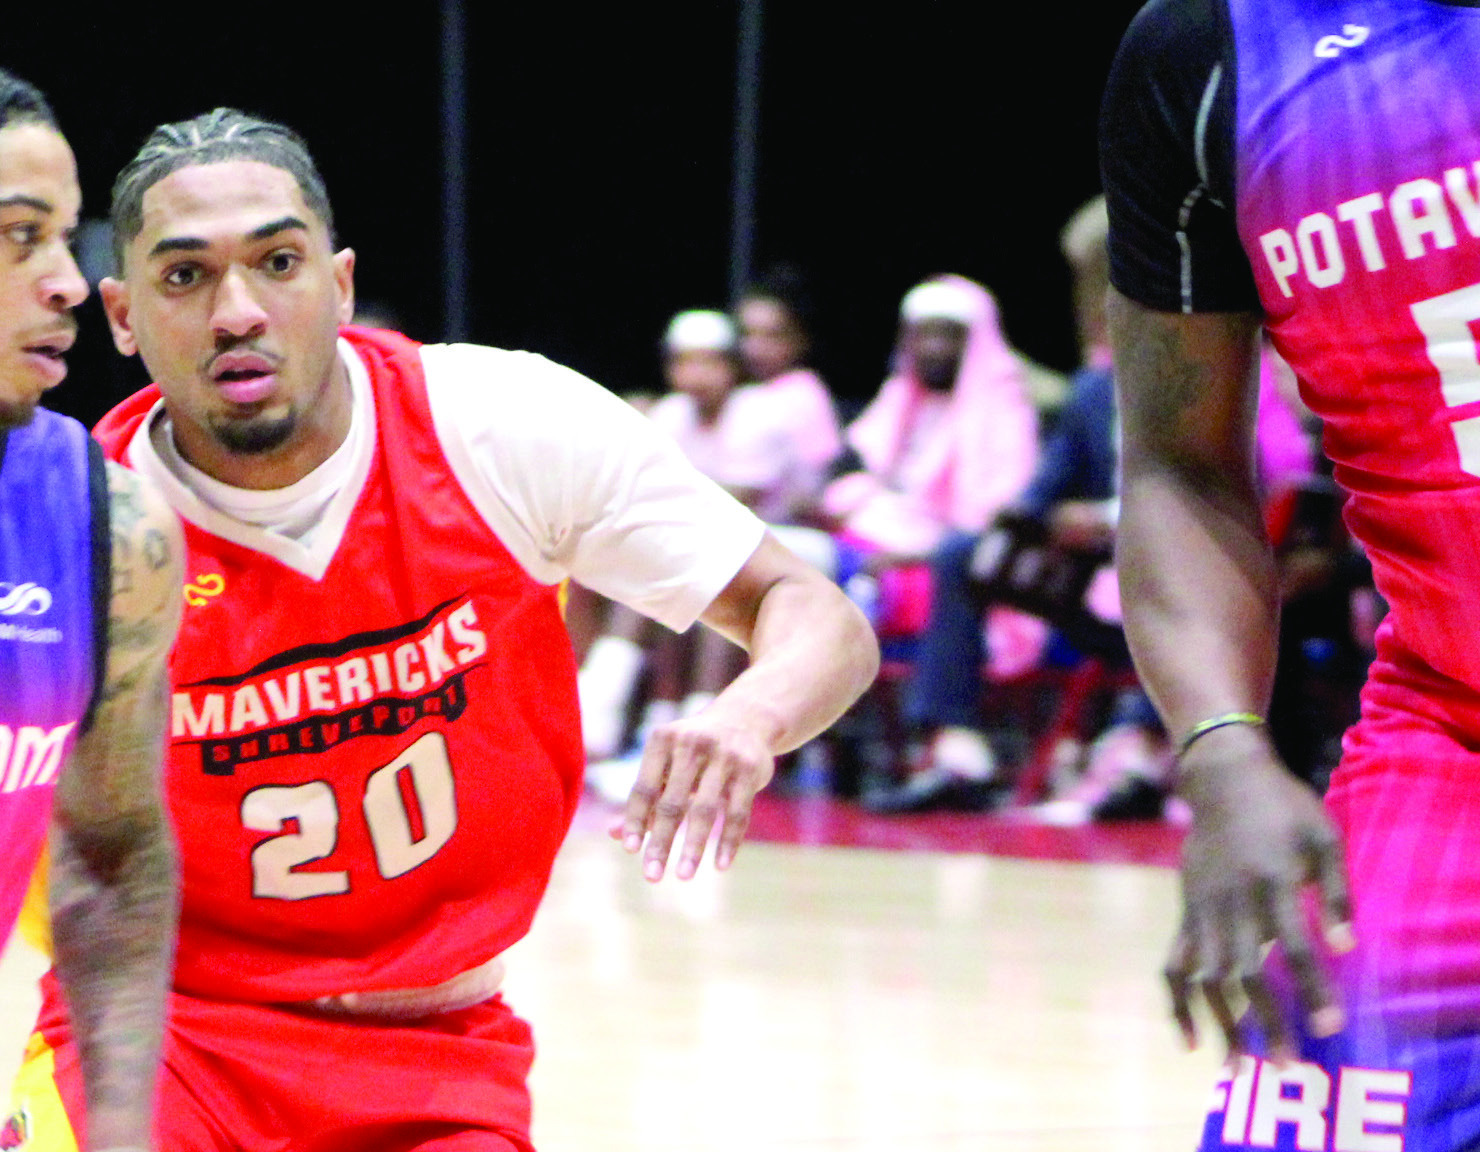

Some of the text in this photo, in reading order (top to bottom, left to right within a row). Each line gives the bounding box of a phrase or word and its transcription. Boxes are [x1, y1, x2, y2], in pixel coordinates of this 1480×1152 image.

[172, 600, 487, 738] MAVERICKS
[212, 683, 458, 762] SHREVEPORT
[240, 730, 459, 900] 20
